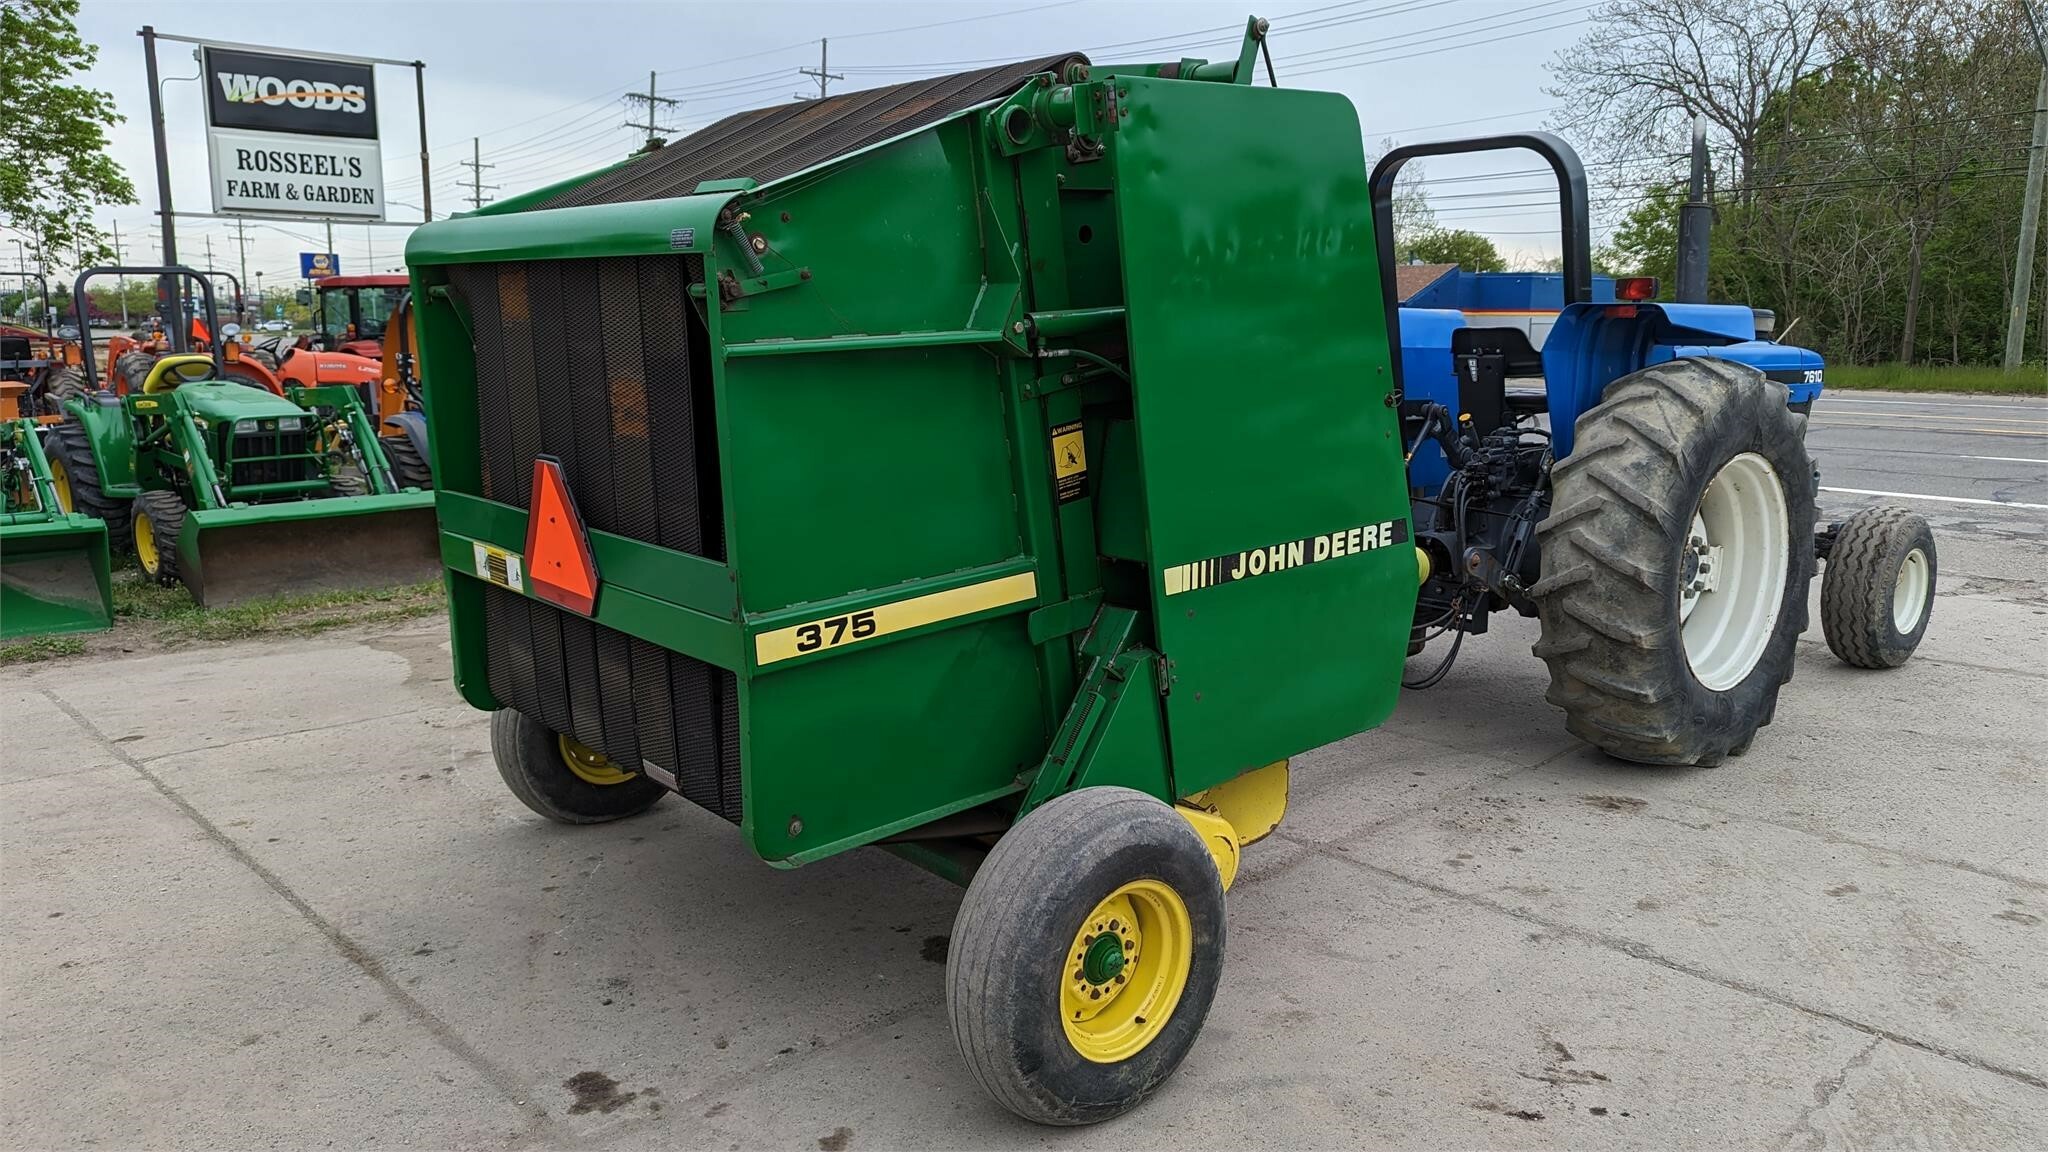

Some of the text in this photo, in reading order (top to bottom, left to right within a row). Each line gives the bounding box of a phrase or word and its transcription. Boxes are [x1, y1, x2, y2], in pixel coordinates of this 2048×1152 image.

[217, 72, 366, 114] WOODS
[236, 148, 362, 178] ROSSEEL'S
[226, 179, 375, 205] FARM & GARDEN
[1803, 369, 1823, 383] 7610
[1056, 421, 1083, 434] WARNING
[1231, 521, 1393, 580] JOHN DEERE
[796, 610, 876, 652] 375
